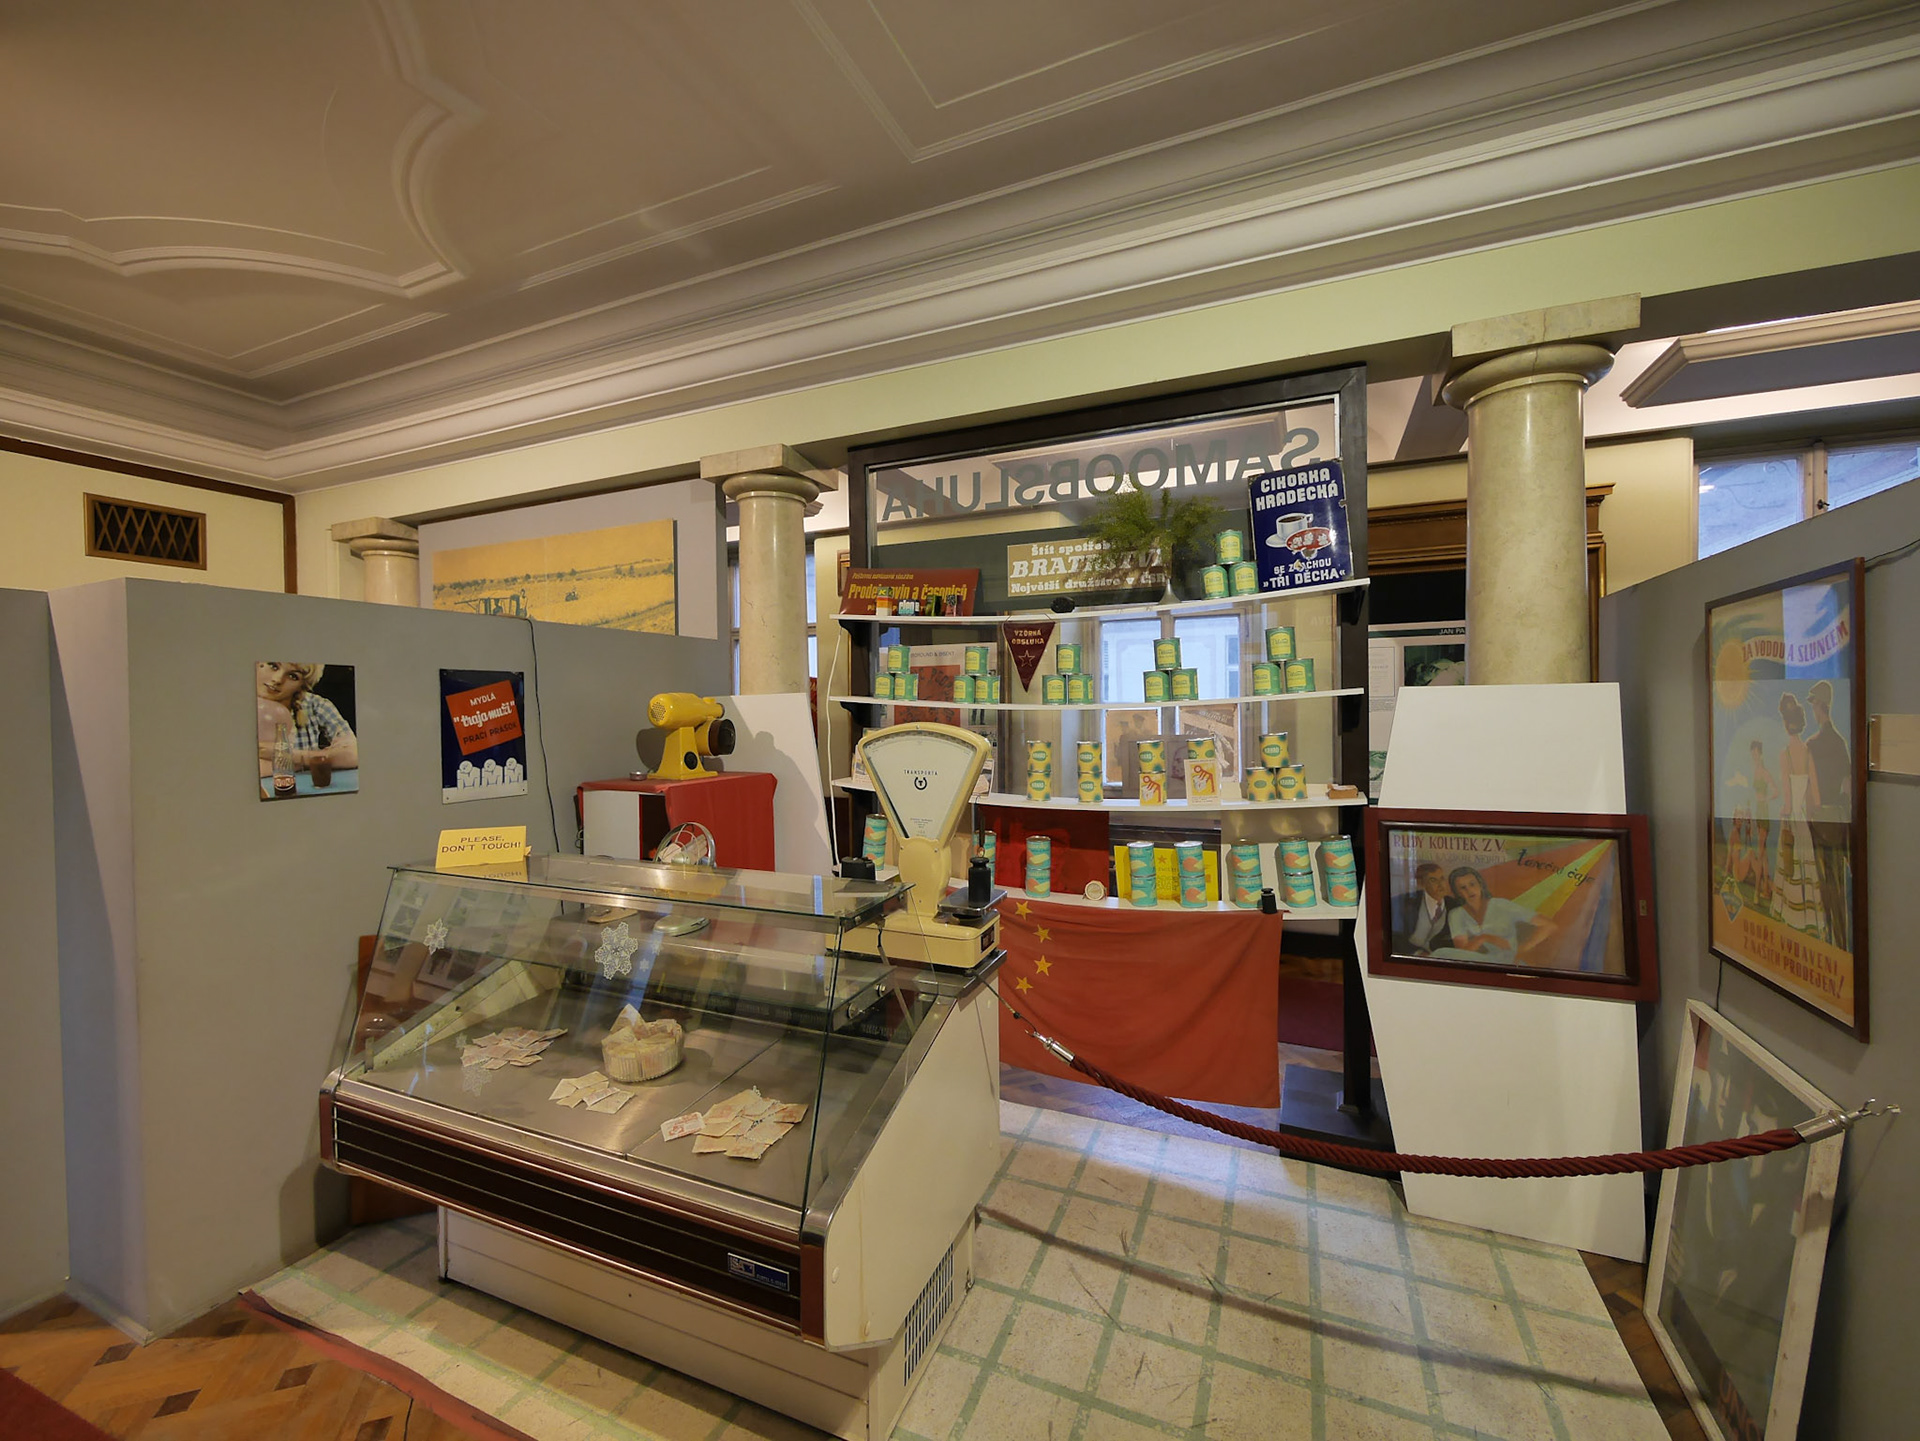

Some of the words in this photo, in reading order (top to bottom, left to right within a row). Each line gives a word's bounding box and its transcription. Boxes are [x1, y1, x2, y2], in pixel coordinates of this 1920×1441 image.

[1273, 565, 1286, 575] SE
[911, 586, 920, 600] a
[1438, 627, 1455, 635] JAN
[1755, 640, 1786, 660] VODOU
[1787, 643, 1795, 662] A
[1797, 620, 1849, 662] SLUNCEM
[482, 841, 521, 851] TOUCH!
[1429, 835, 1479, 852] KOUTEK
